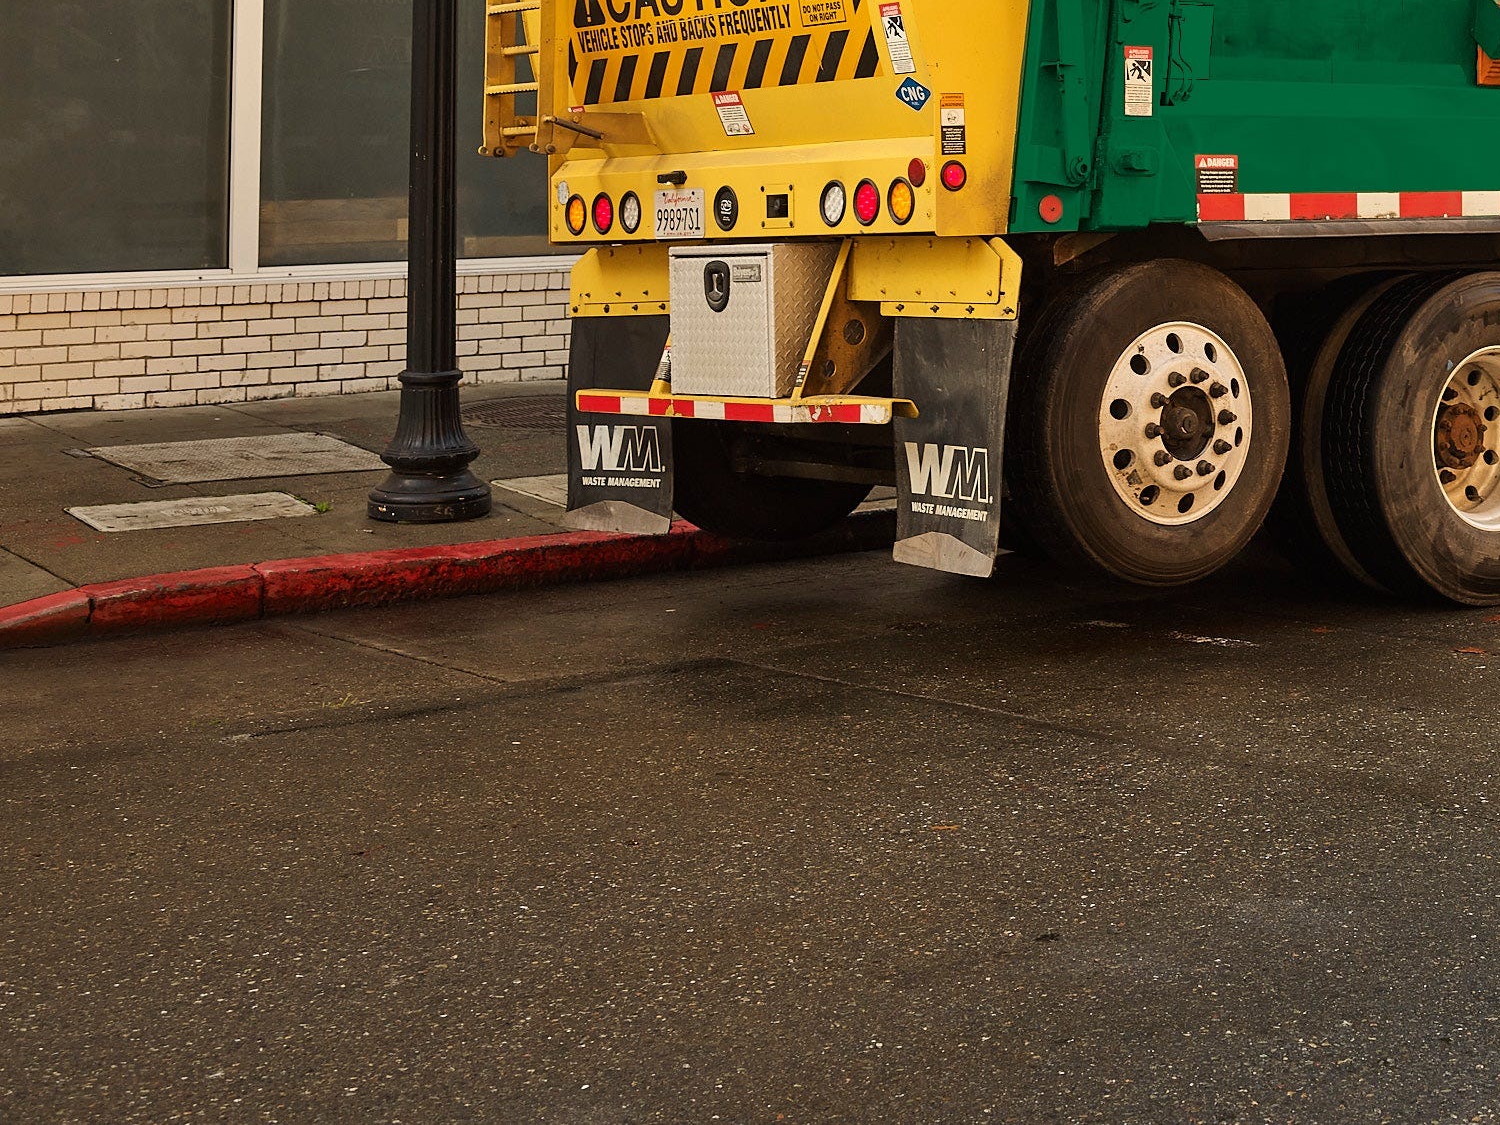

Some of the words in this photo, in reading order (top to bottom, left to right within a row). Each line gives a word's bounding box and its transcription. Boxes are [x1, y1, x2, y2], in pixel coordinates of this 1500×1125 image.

[803, 5, 811, 14] DO
[812, 3, 824, 12] NOT
[825, 1, 841, 10] PASS
[809, 14, 818, 22] ON
[819, 11, 837, 21] RIGHT
[577, 26, 620, 54] VEHICLE
[620, 22, 655, 49] STOPS
[656, 20, 678, 44] AND
[679, 15, 717, 42] BACKS
[719, 4, 792, 39] FREQUENTLY
[901, 85, 926, 102] CNG
[1207, 158, 1235, 168] DANGER
[657, 208, 701, 231] 99897S1
[576, 424, 661, 473] WM
[904, 441, 989, 504] WM
[582, 476, 607, 487] WASTE
[607, 477, 662, 489] MANAGEMENT
[911, 501, 935, 515] WASTE
[934, 504, 988, 522] MANAGEMENT
